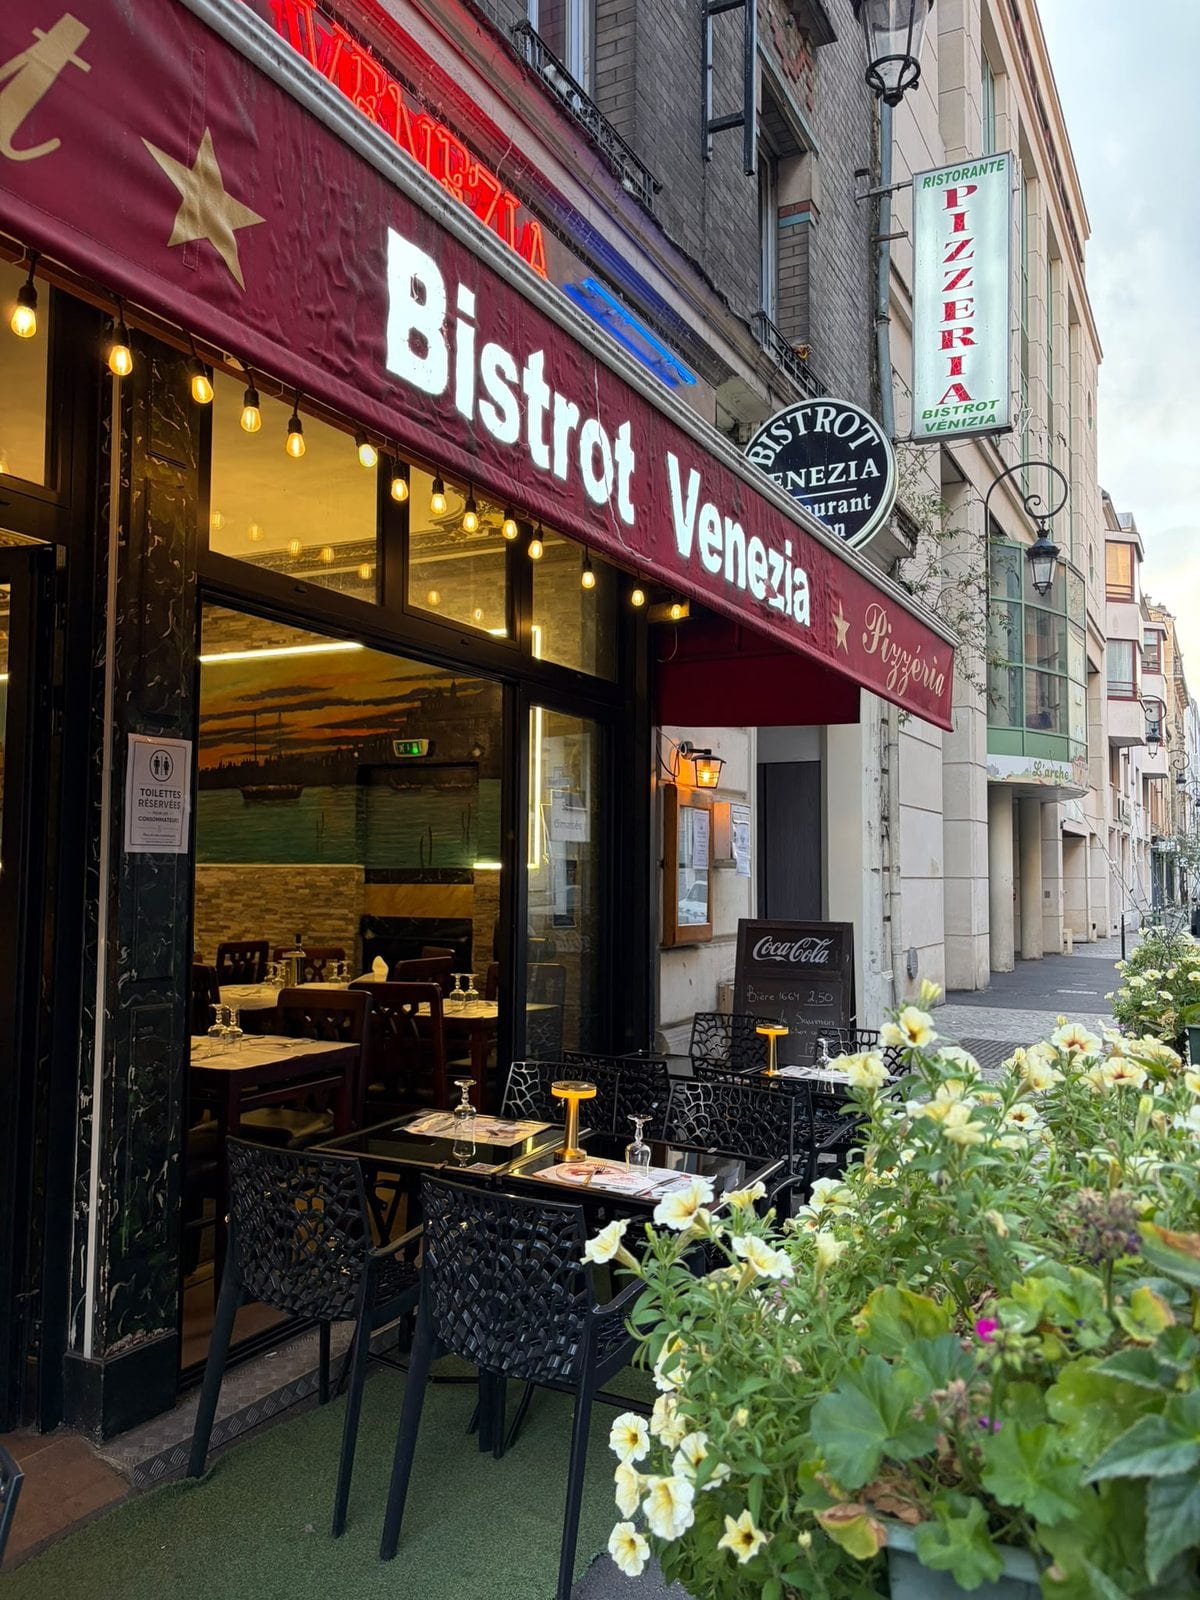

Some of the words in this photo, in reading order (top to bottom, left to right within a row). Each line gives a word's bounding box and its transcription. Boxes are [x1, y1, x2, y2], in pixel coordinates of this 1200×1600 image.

[922, 159, 1005, 189] RISTORANTE
[936, 184, 979, 406] PIZZERIA
[922, 400, 1000, 420] BISTROT
[386, 226, 636, 526] Bistrot
[667, 450, 811, 628] Venezia
[749, 405, 881, 468] BISTROT
[768, 458, 881, 491] ENEZIA
[862, 603, 945, 697] Pizzéria
[138, 798, 181, 810] RÉSERVÉES
[140, 787, 182, 800] TOILETTES
[752, 935, 834, 964] Coca-Cola
